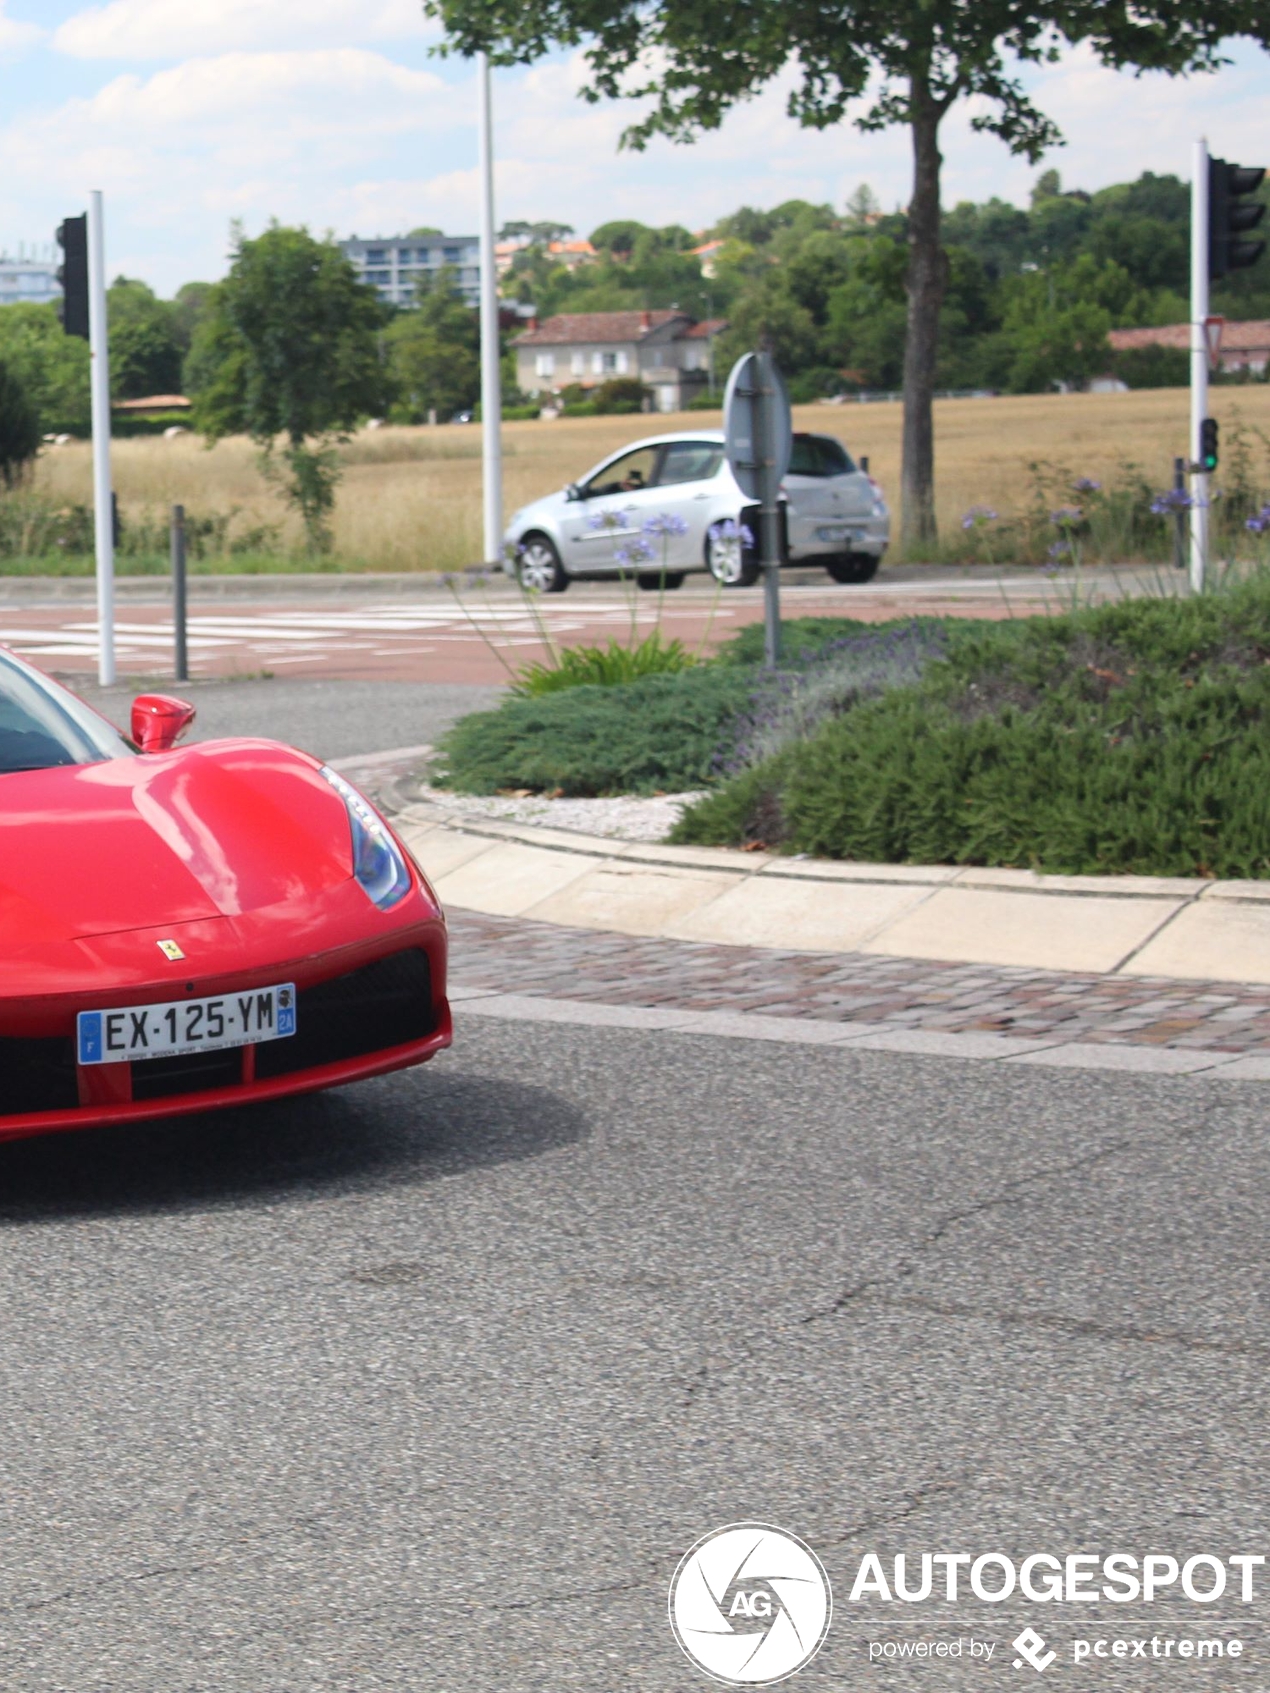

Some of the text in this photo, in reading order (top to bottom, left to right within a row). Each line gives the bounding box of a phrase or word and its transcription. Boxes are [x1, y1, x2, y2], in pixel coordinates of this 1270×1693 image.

[106, 992, 273, 1051] EX-125-YM
[279, 1014, 293, 1031] 2A
[86, 1042, 94, 1053] F
